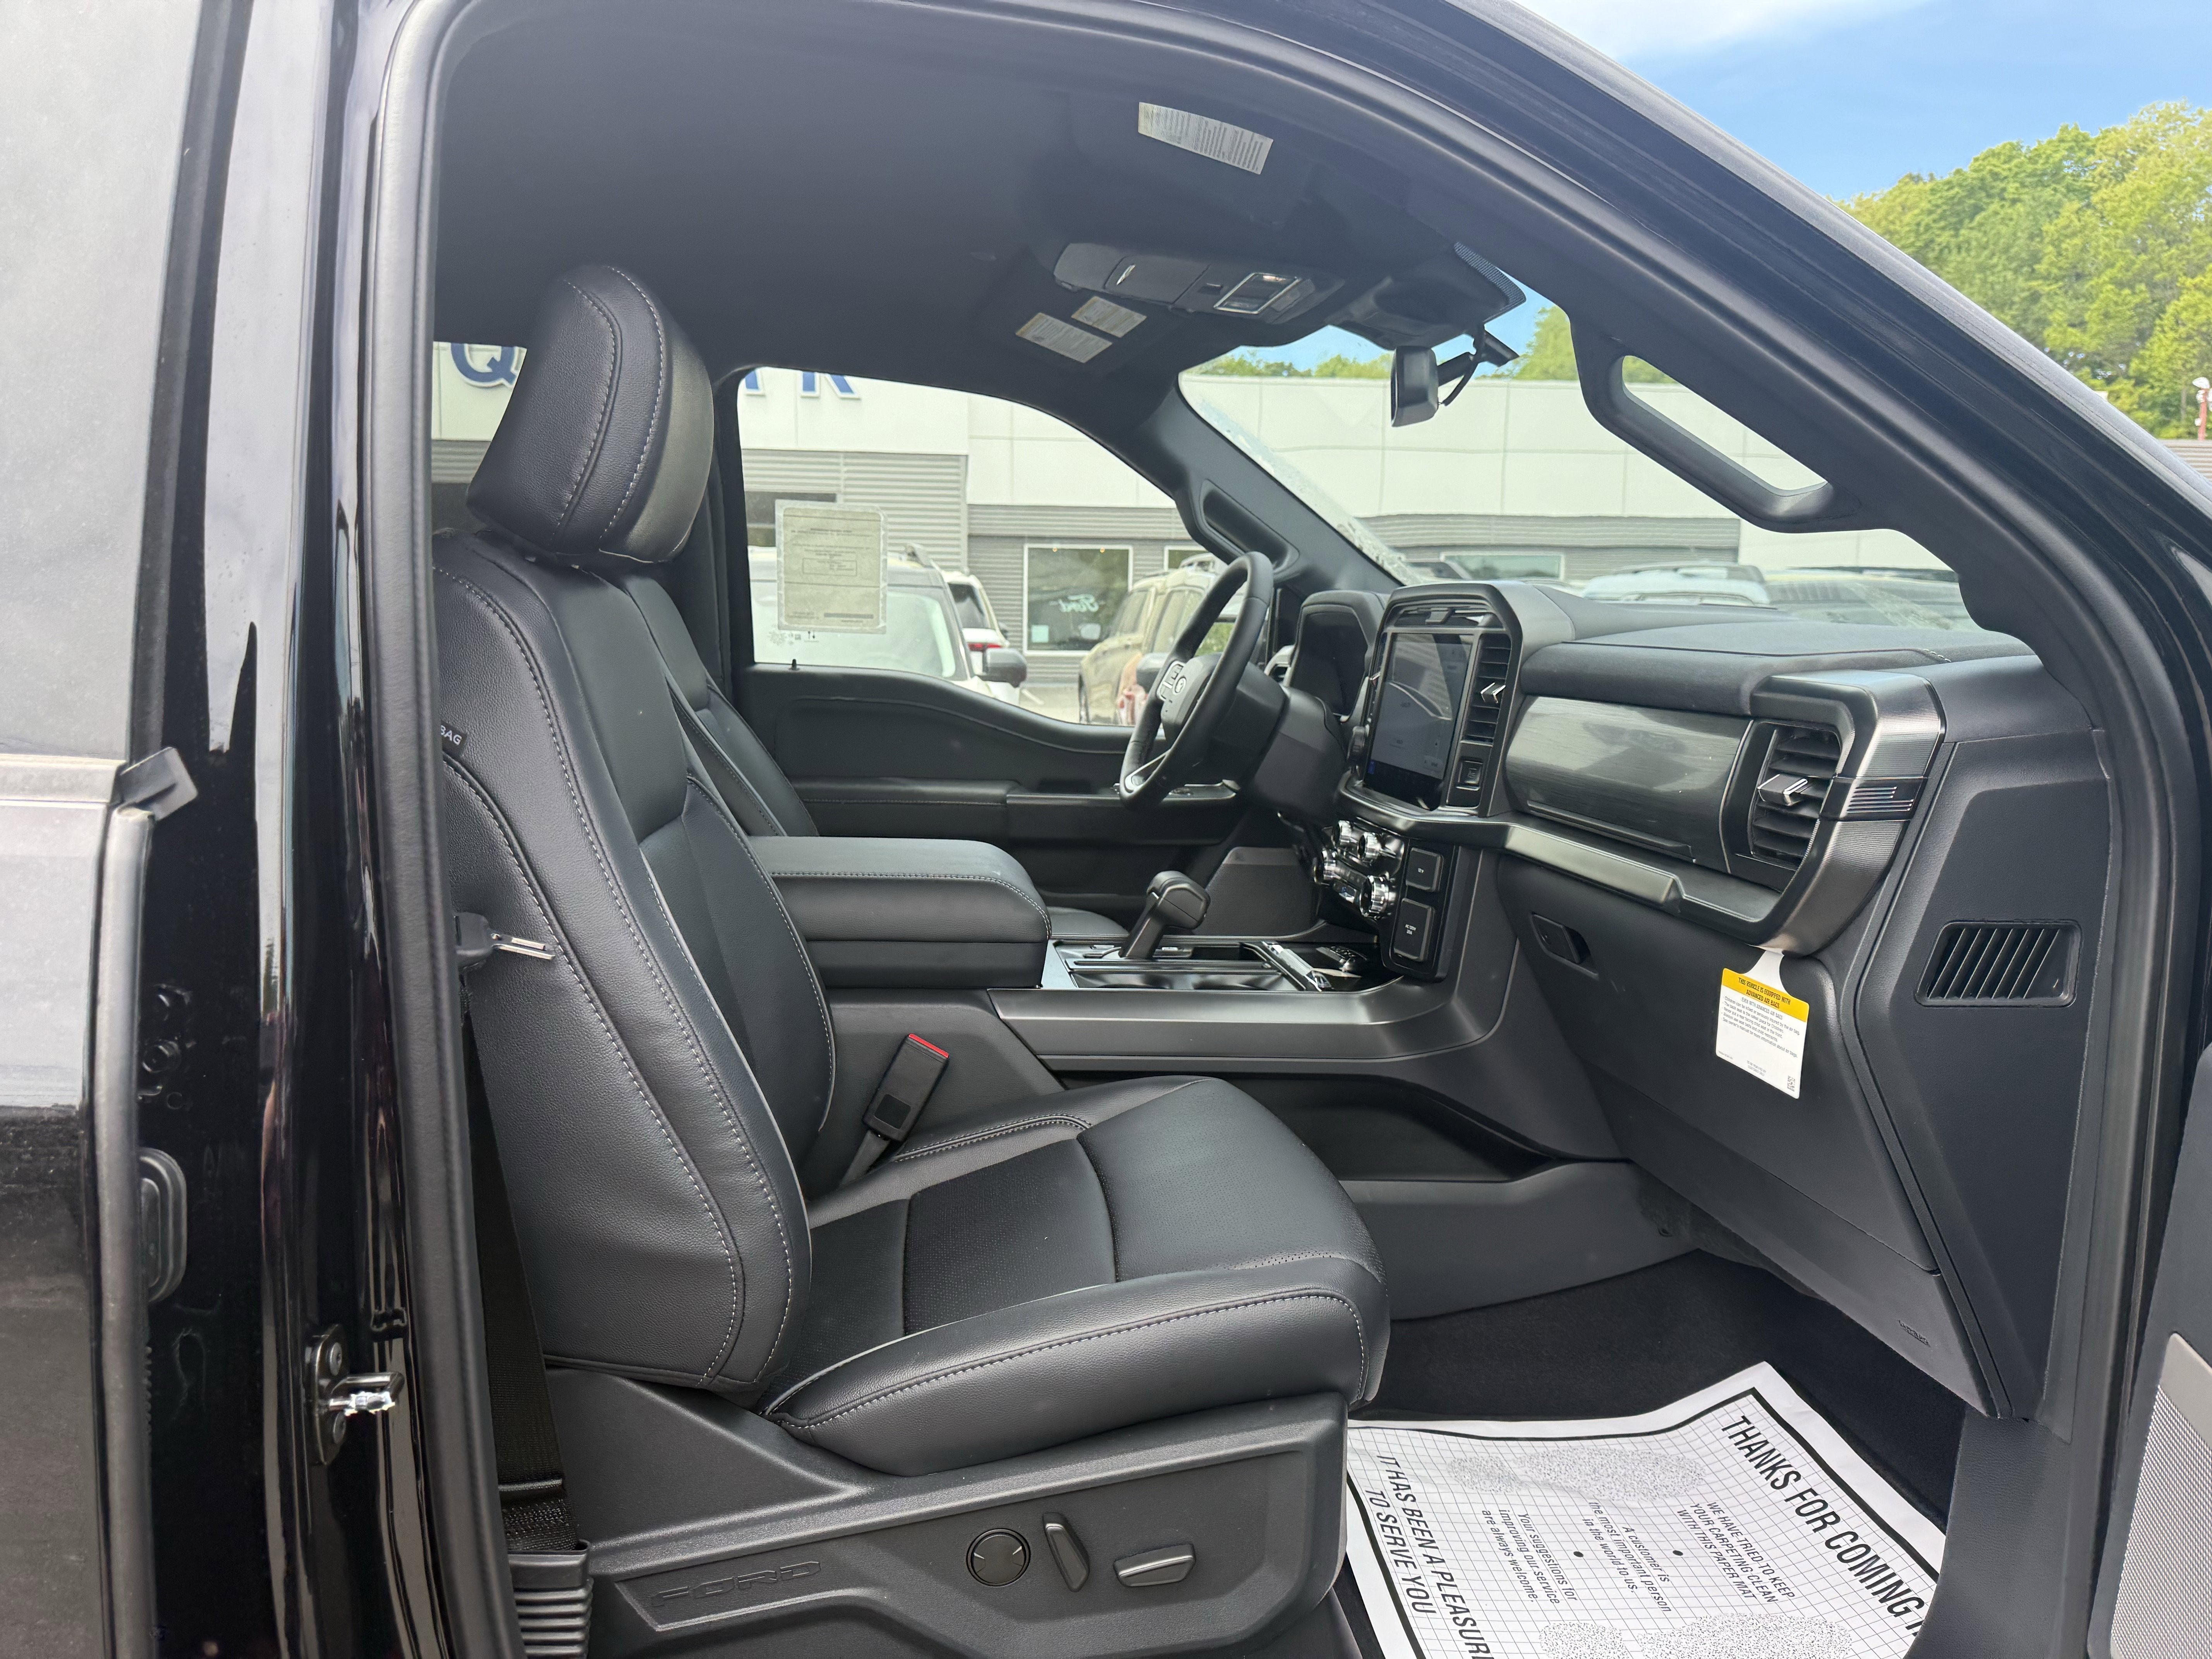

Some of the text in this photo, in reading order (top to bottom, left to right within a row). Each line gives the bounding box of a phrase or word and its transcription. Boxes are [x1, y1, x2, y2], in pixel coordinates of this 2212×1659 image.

[1365, 1489, 1437, 1614] TO SERVE YOU
[1376, 1455, 1495, 1659] IT HAS BEEN A PLEASUR
[1482, 1510, 1538, 1602] are always welcome.
[1498, 1510, 1560, 1604] improving our service
[1518, 1513, 1578, 1601] Your suggestions for
[1589, 1502, 1672, 1612] the most important person
[1589, 1528, 1604, 1540] the
[1599, 1543, 1625, 1565] world
[1616, 1567, 1629, 1576] to
[1624, 1578, 1638, 1593] us.
[1628, 1535, 1663, 1571] customer
[1657, 1574, 1669, 1582] is
[1677, 1510, 1757, 1599] WITH THIS PAPER MAT
[1690, 1503, 1779, 1602] YOUR CARPETING CLEAN
[1707, 1502, 1795, 1598] WE HAVE TRIED TO KEEP
[1721, 1415, 1925, 1618] THANKS FOR COMING
[651, 1561, 821, 1607] FORD
